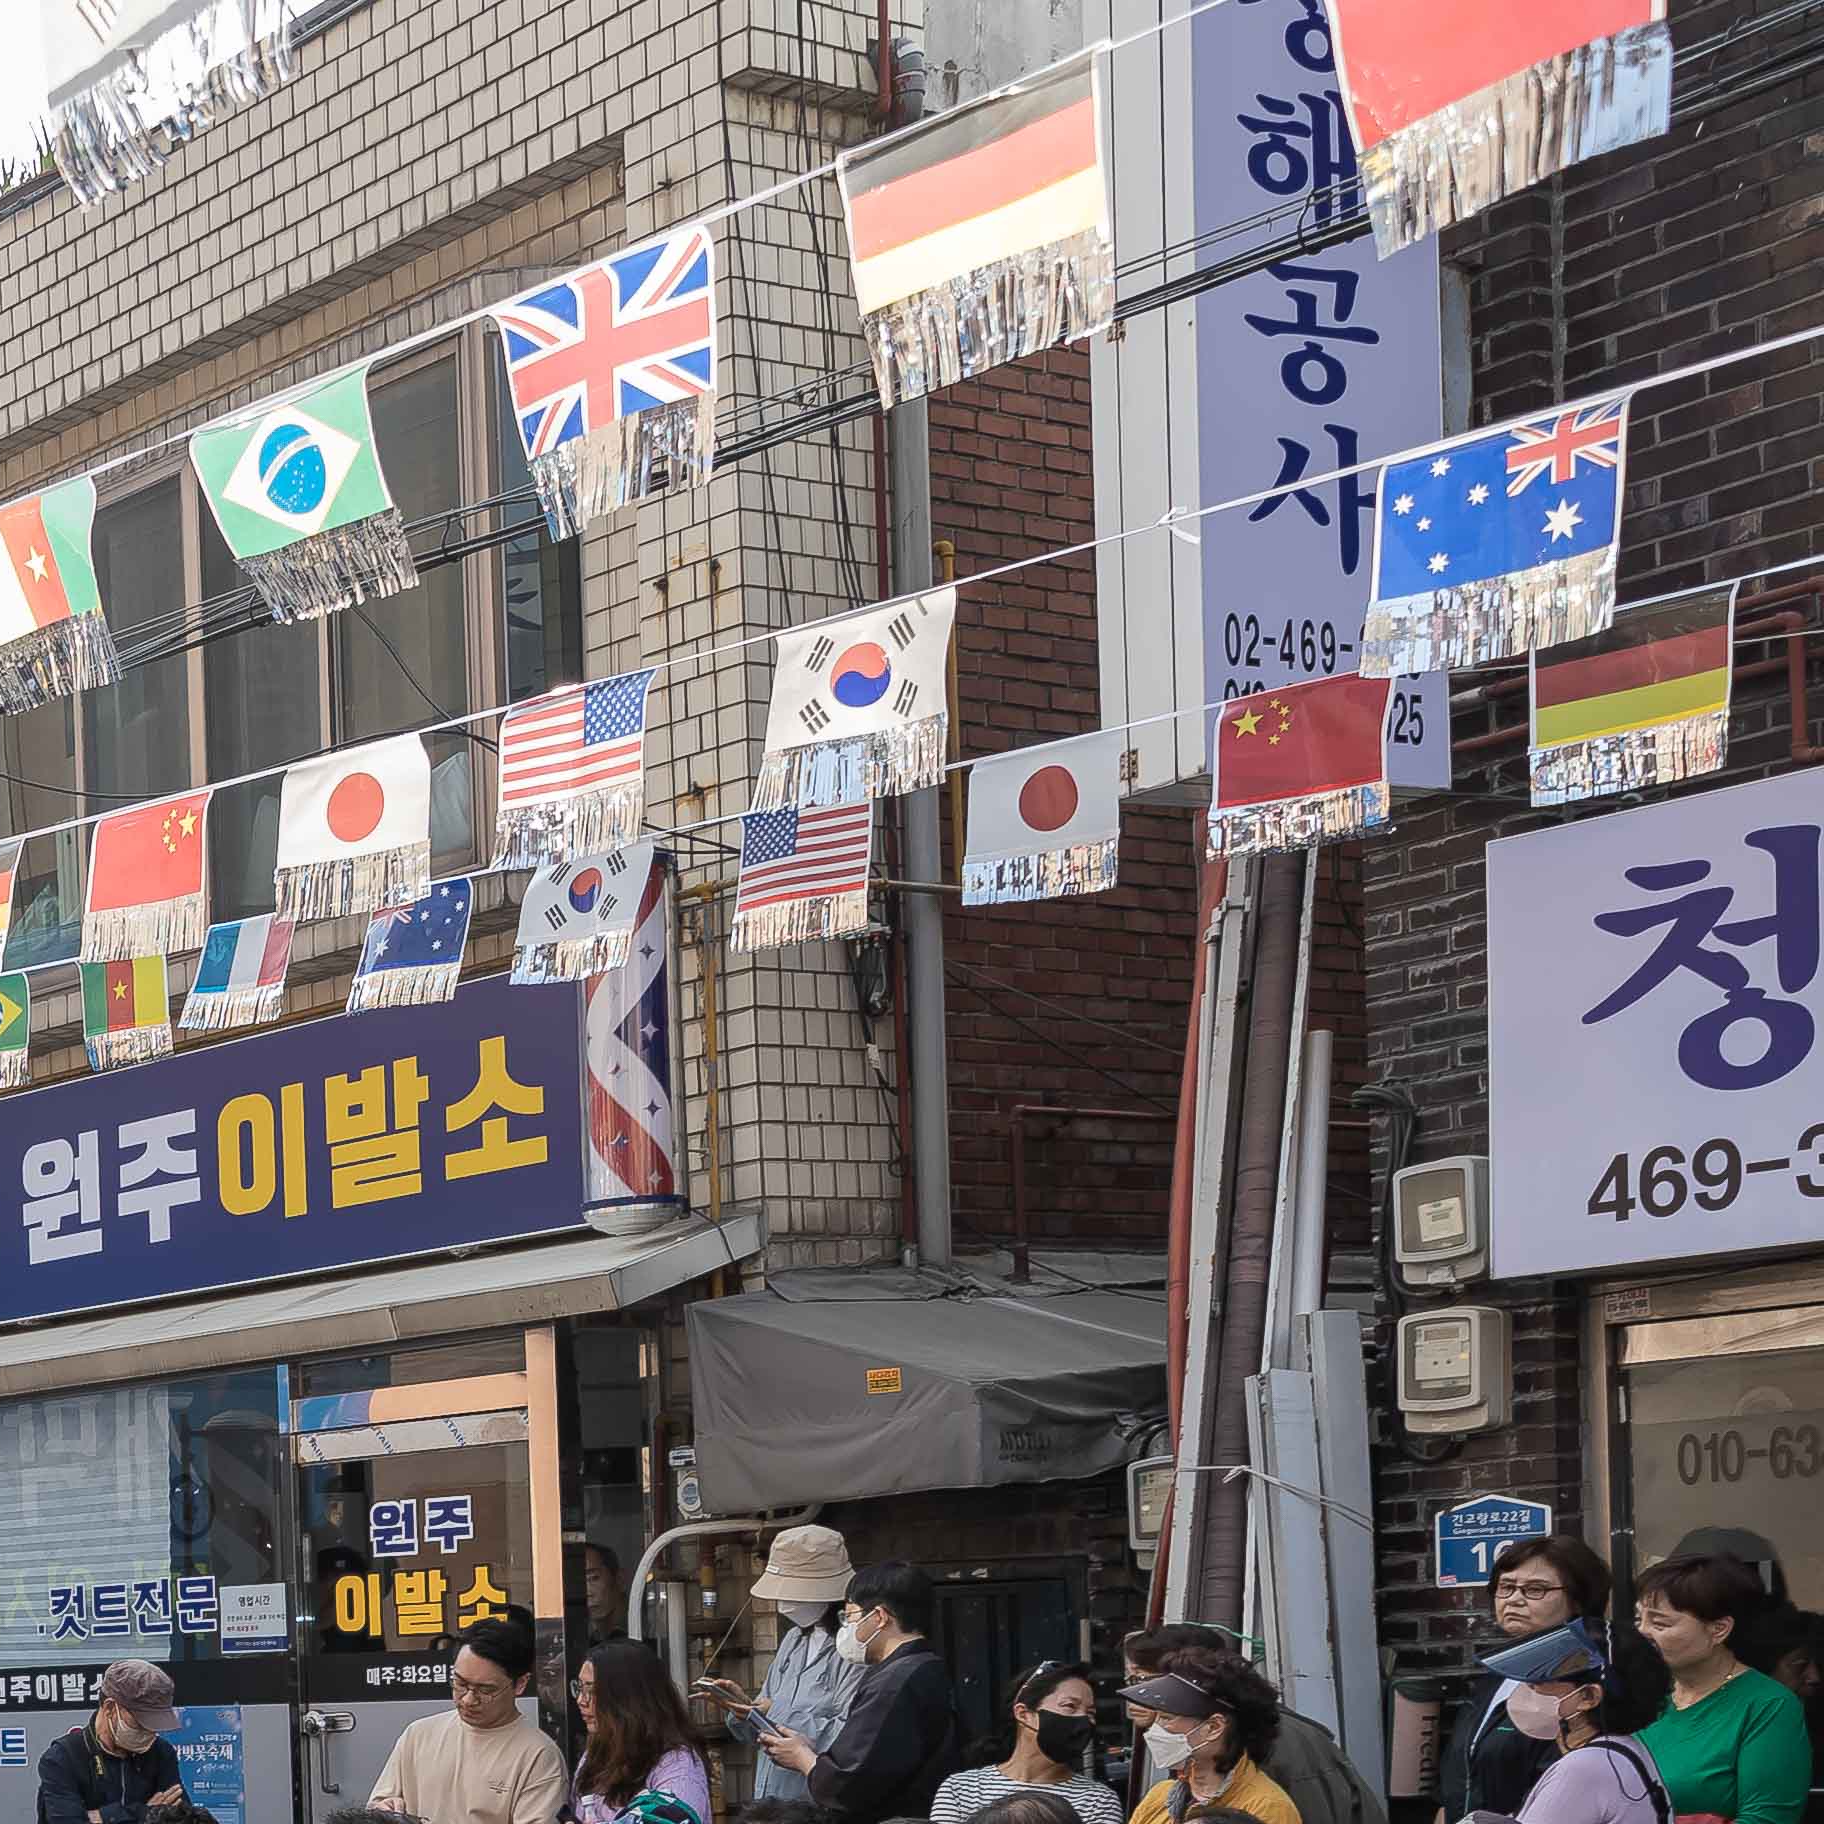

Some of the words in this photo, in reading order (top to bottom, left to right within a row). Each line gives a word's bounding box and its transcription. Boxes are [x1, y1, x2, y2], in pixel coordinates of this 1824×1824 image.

[1581, 825, 1821, 1092] 청
[20, 1035, 550, 1266] 원주이발소
[370, 1494, 474, 1558] 원주
[1452, 1510, 1530, 1527] 긴고랑로22길
[335, 1565, 509, 1637] 이발소
[366, 1663, 456, 1686] 매주:화요일
